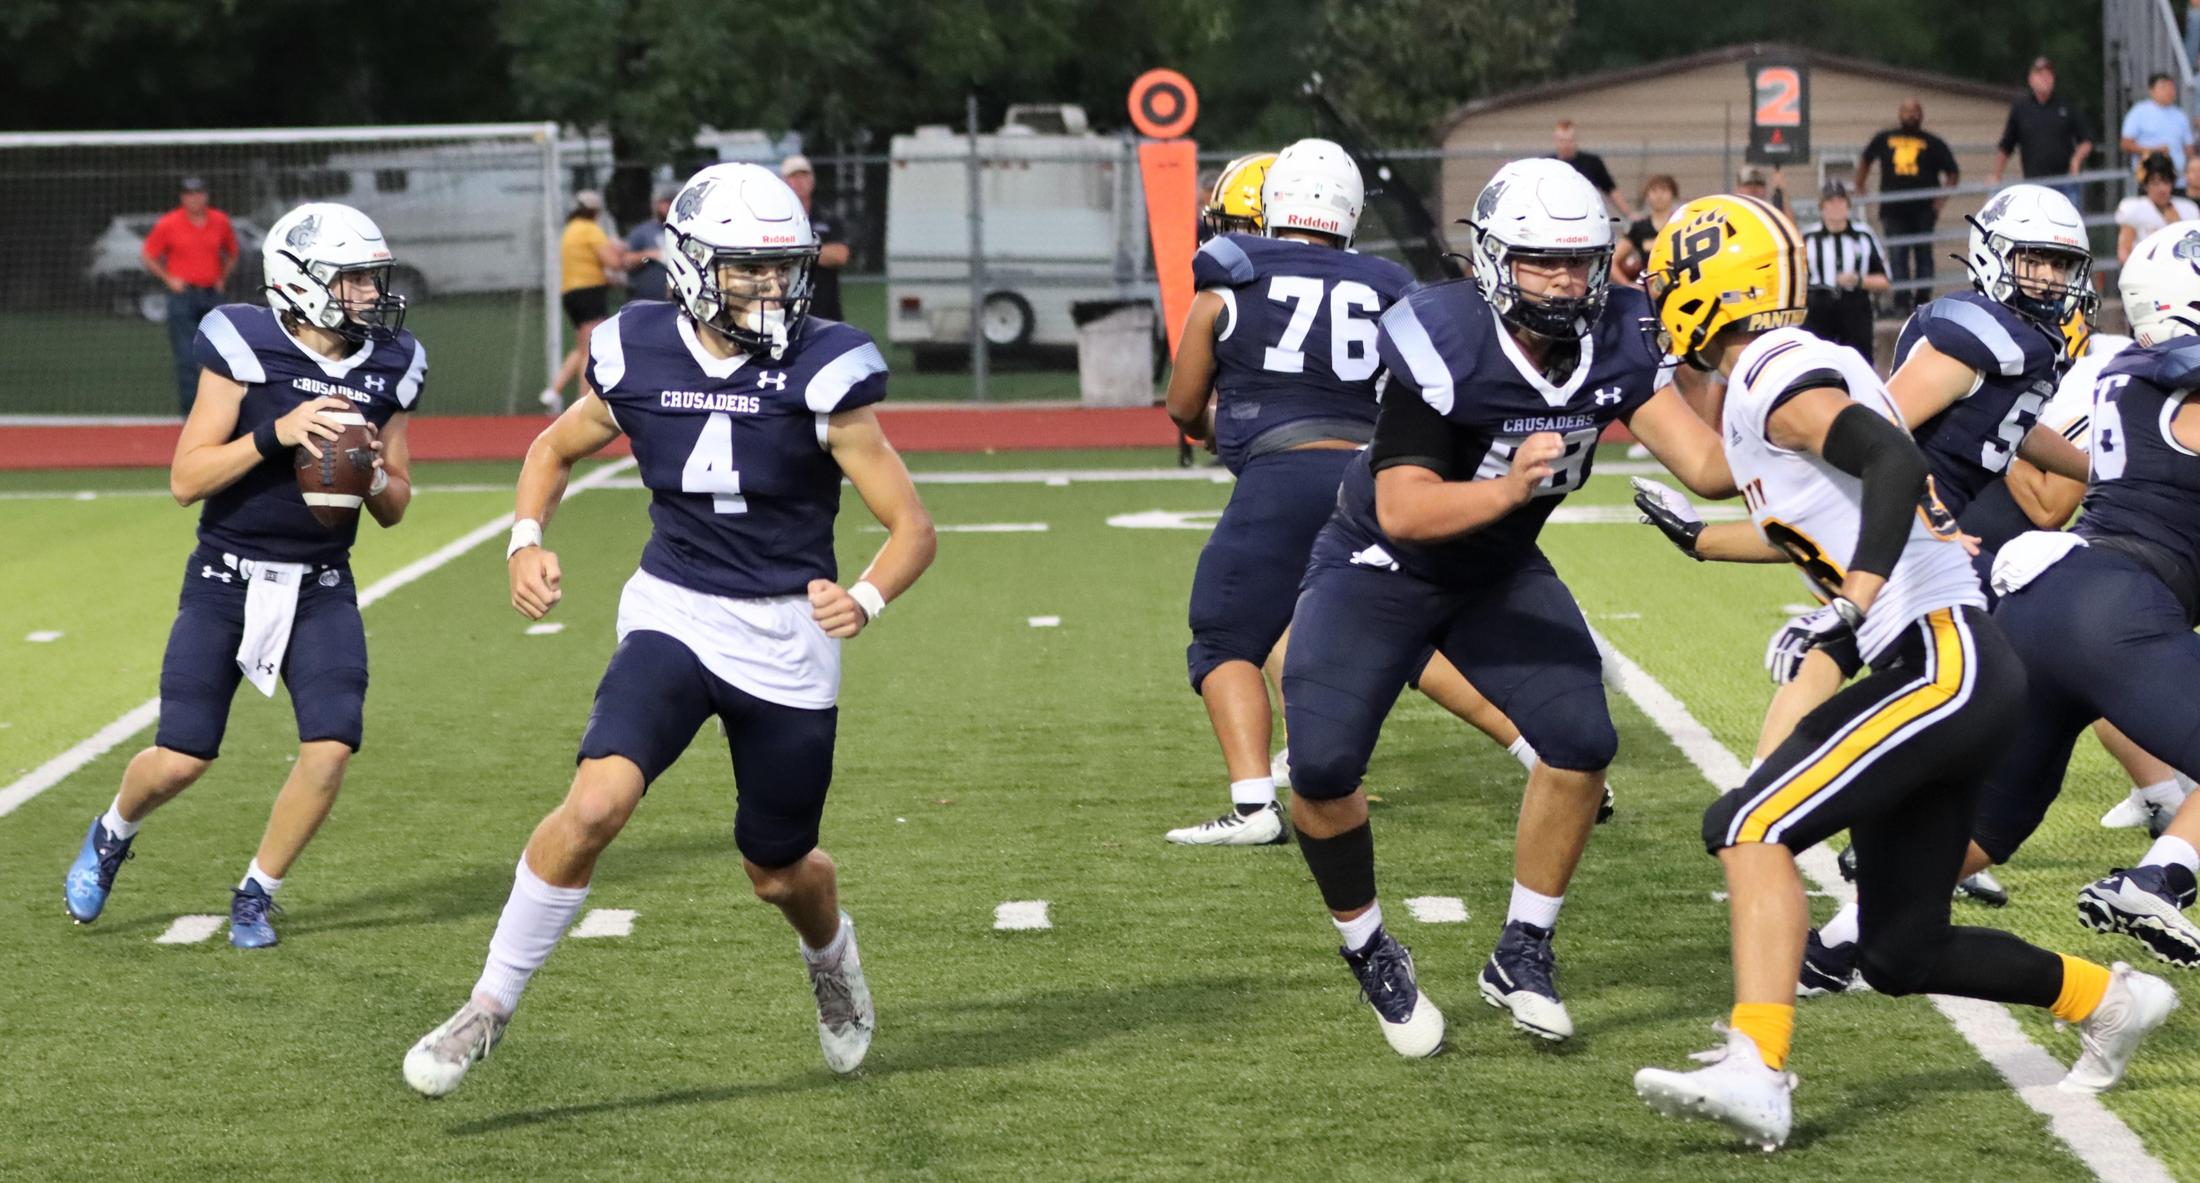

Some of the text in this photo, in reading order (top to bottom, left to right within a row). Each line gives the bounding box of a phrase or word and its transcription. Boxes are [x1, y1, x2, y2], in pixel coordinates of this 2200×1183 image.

[1755, 66, 1801, 127] 2
[1287, 213, 1340, 233] Riddell
[761, 234, 796, 244] Riddell
[1262, 275, 1382, 382] 76
[660, 390, 761, 414] CRUSADERS
[1502, 413, 1596, 433] CRUSADERS
[681, 411, 749, 514] 4
